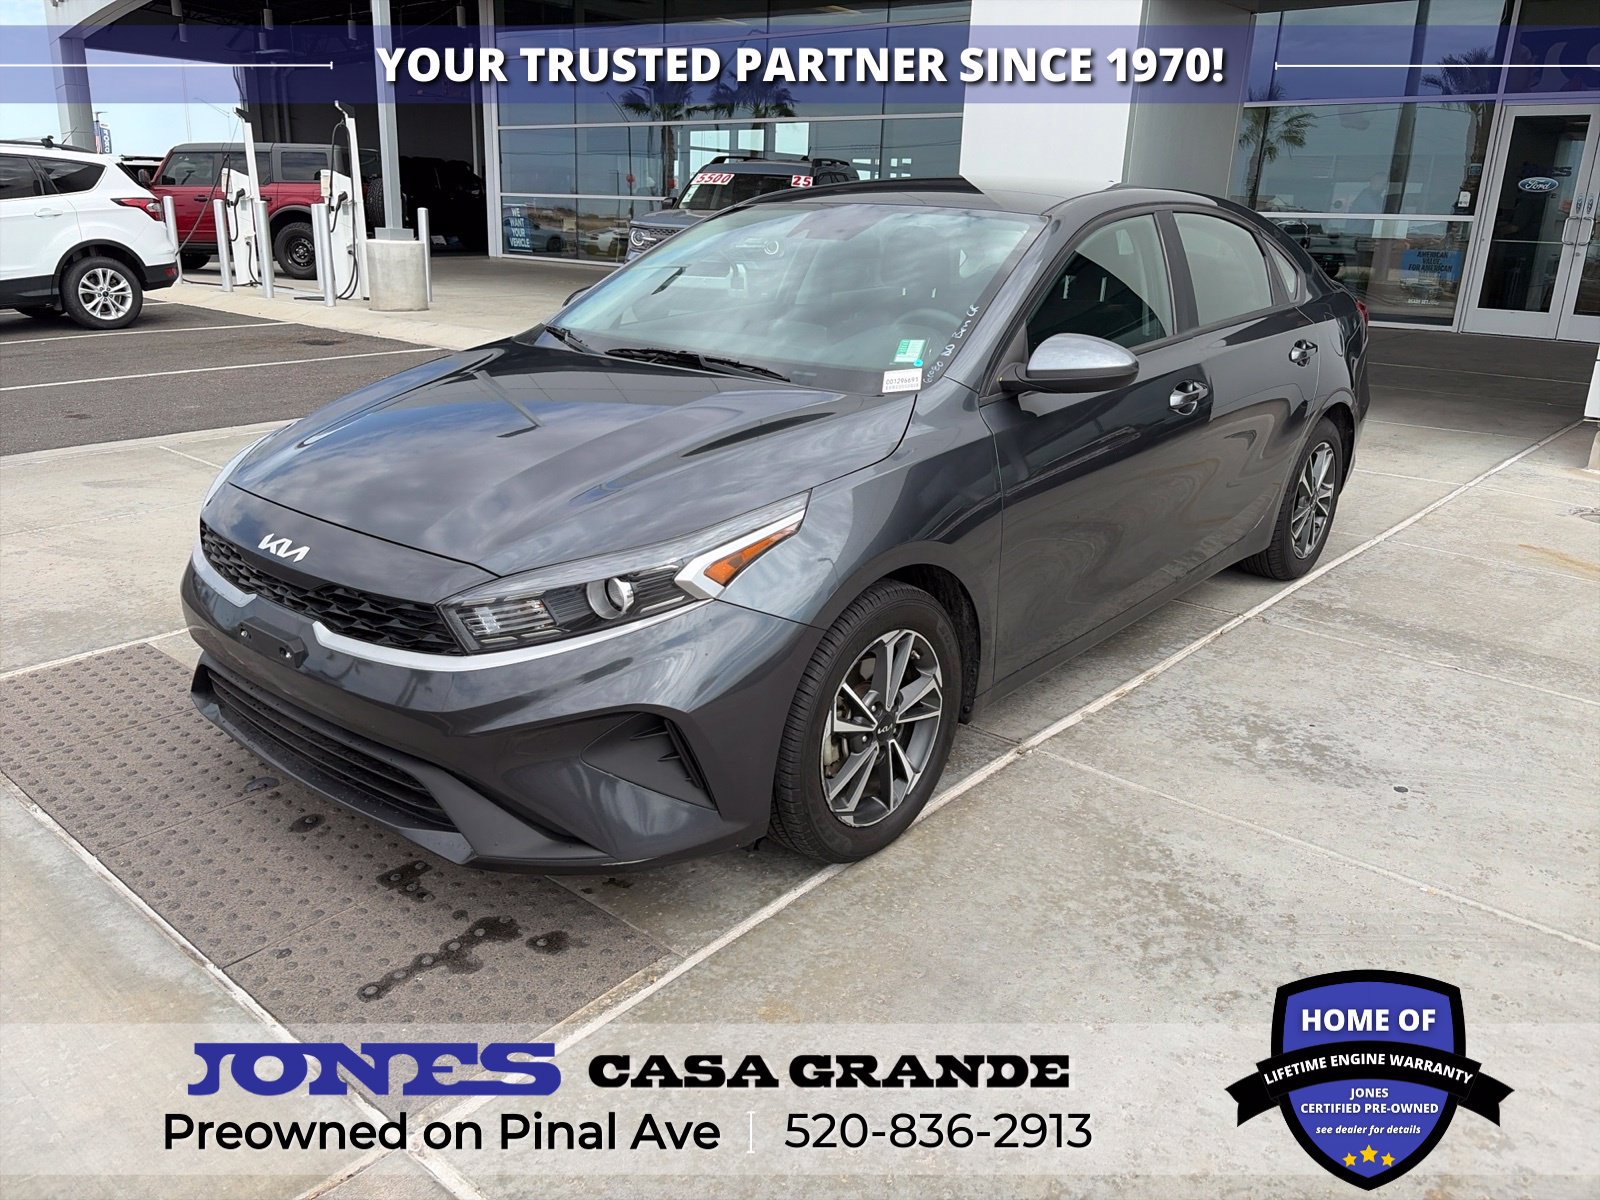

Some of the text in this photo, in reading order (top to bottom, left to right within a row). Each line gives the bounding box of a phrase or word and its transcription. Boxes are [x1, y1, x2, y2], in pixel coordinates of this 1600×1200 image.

[696, 173, 732, 184] 5500
[792, 175, 812, 187] 25
[511, 207, 520, 217] WE
[509, 217, 525, 227] WANT
[511, 227, 526, 238] YOUR
[509, 237, 530, 248] VEHICLE
[258, 532, 311, 563] KIA
